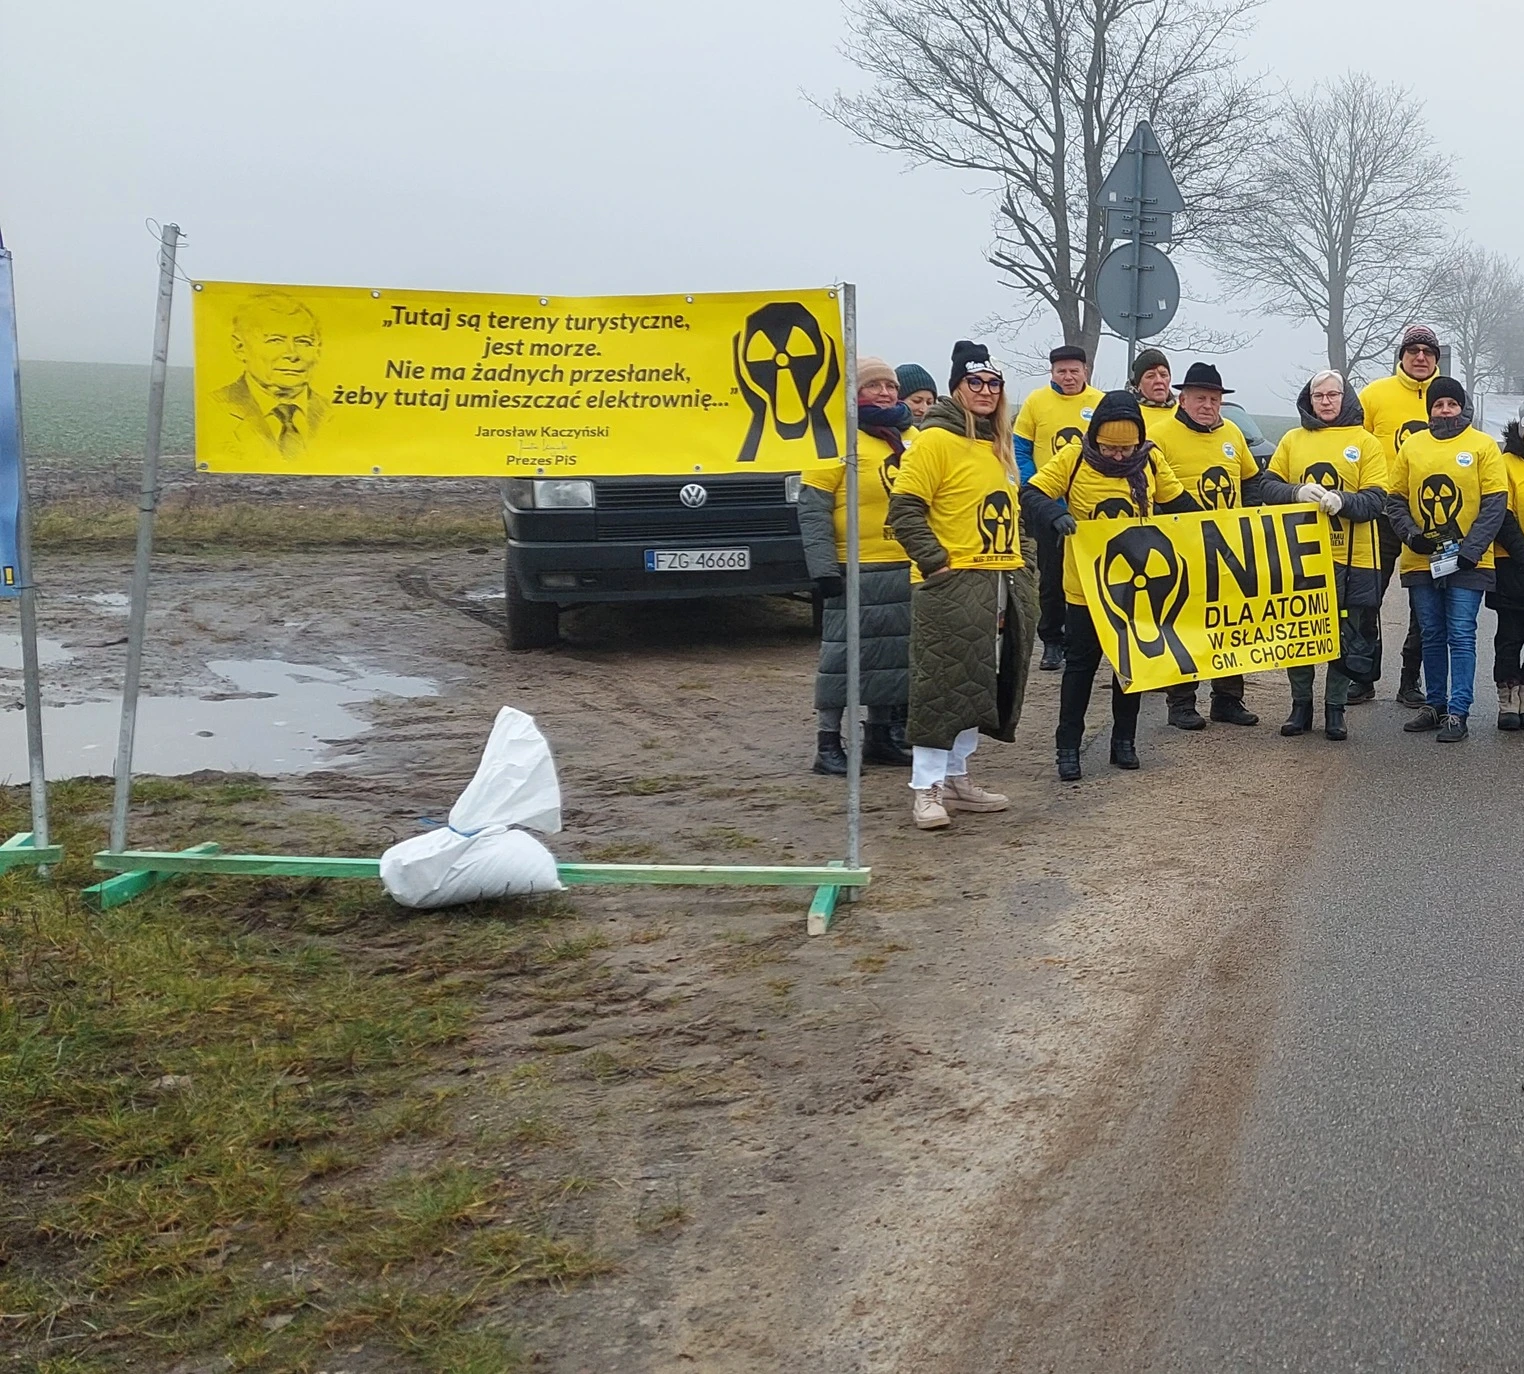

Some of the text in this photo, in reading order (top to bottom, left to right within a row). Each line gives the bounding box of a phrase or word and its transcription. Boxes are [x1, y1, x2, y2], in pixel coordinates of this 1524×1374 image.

[382, 305, 690, 334] „Tutaj są tereny turystyczne,
[481, 336, 602, 359] jest morze.
[385, 359, 691, 386] Nie ma żadnych przesłanek,
[332, 385, 388, 409] żeby
[393, 388, 450, 411] tutaj
[455, 389, 582, 409] umieszczać
[475, 426, 610, 439] Jarosław Kaczyński
[506, 455, 577, 466] Prezes PiS
[656, 552, 747, 569] FZG 46668
[1200, 510, 1327, 603] NIE
[1204, 592, 1329, 629] DLA ATOMU
[1207, 617, 1332, 650] W SŁAJSZEWIE
[1211, 637, 1334, 670] GM. CHOCZEWO
